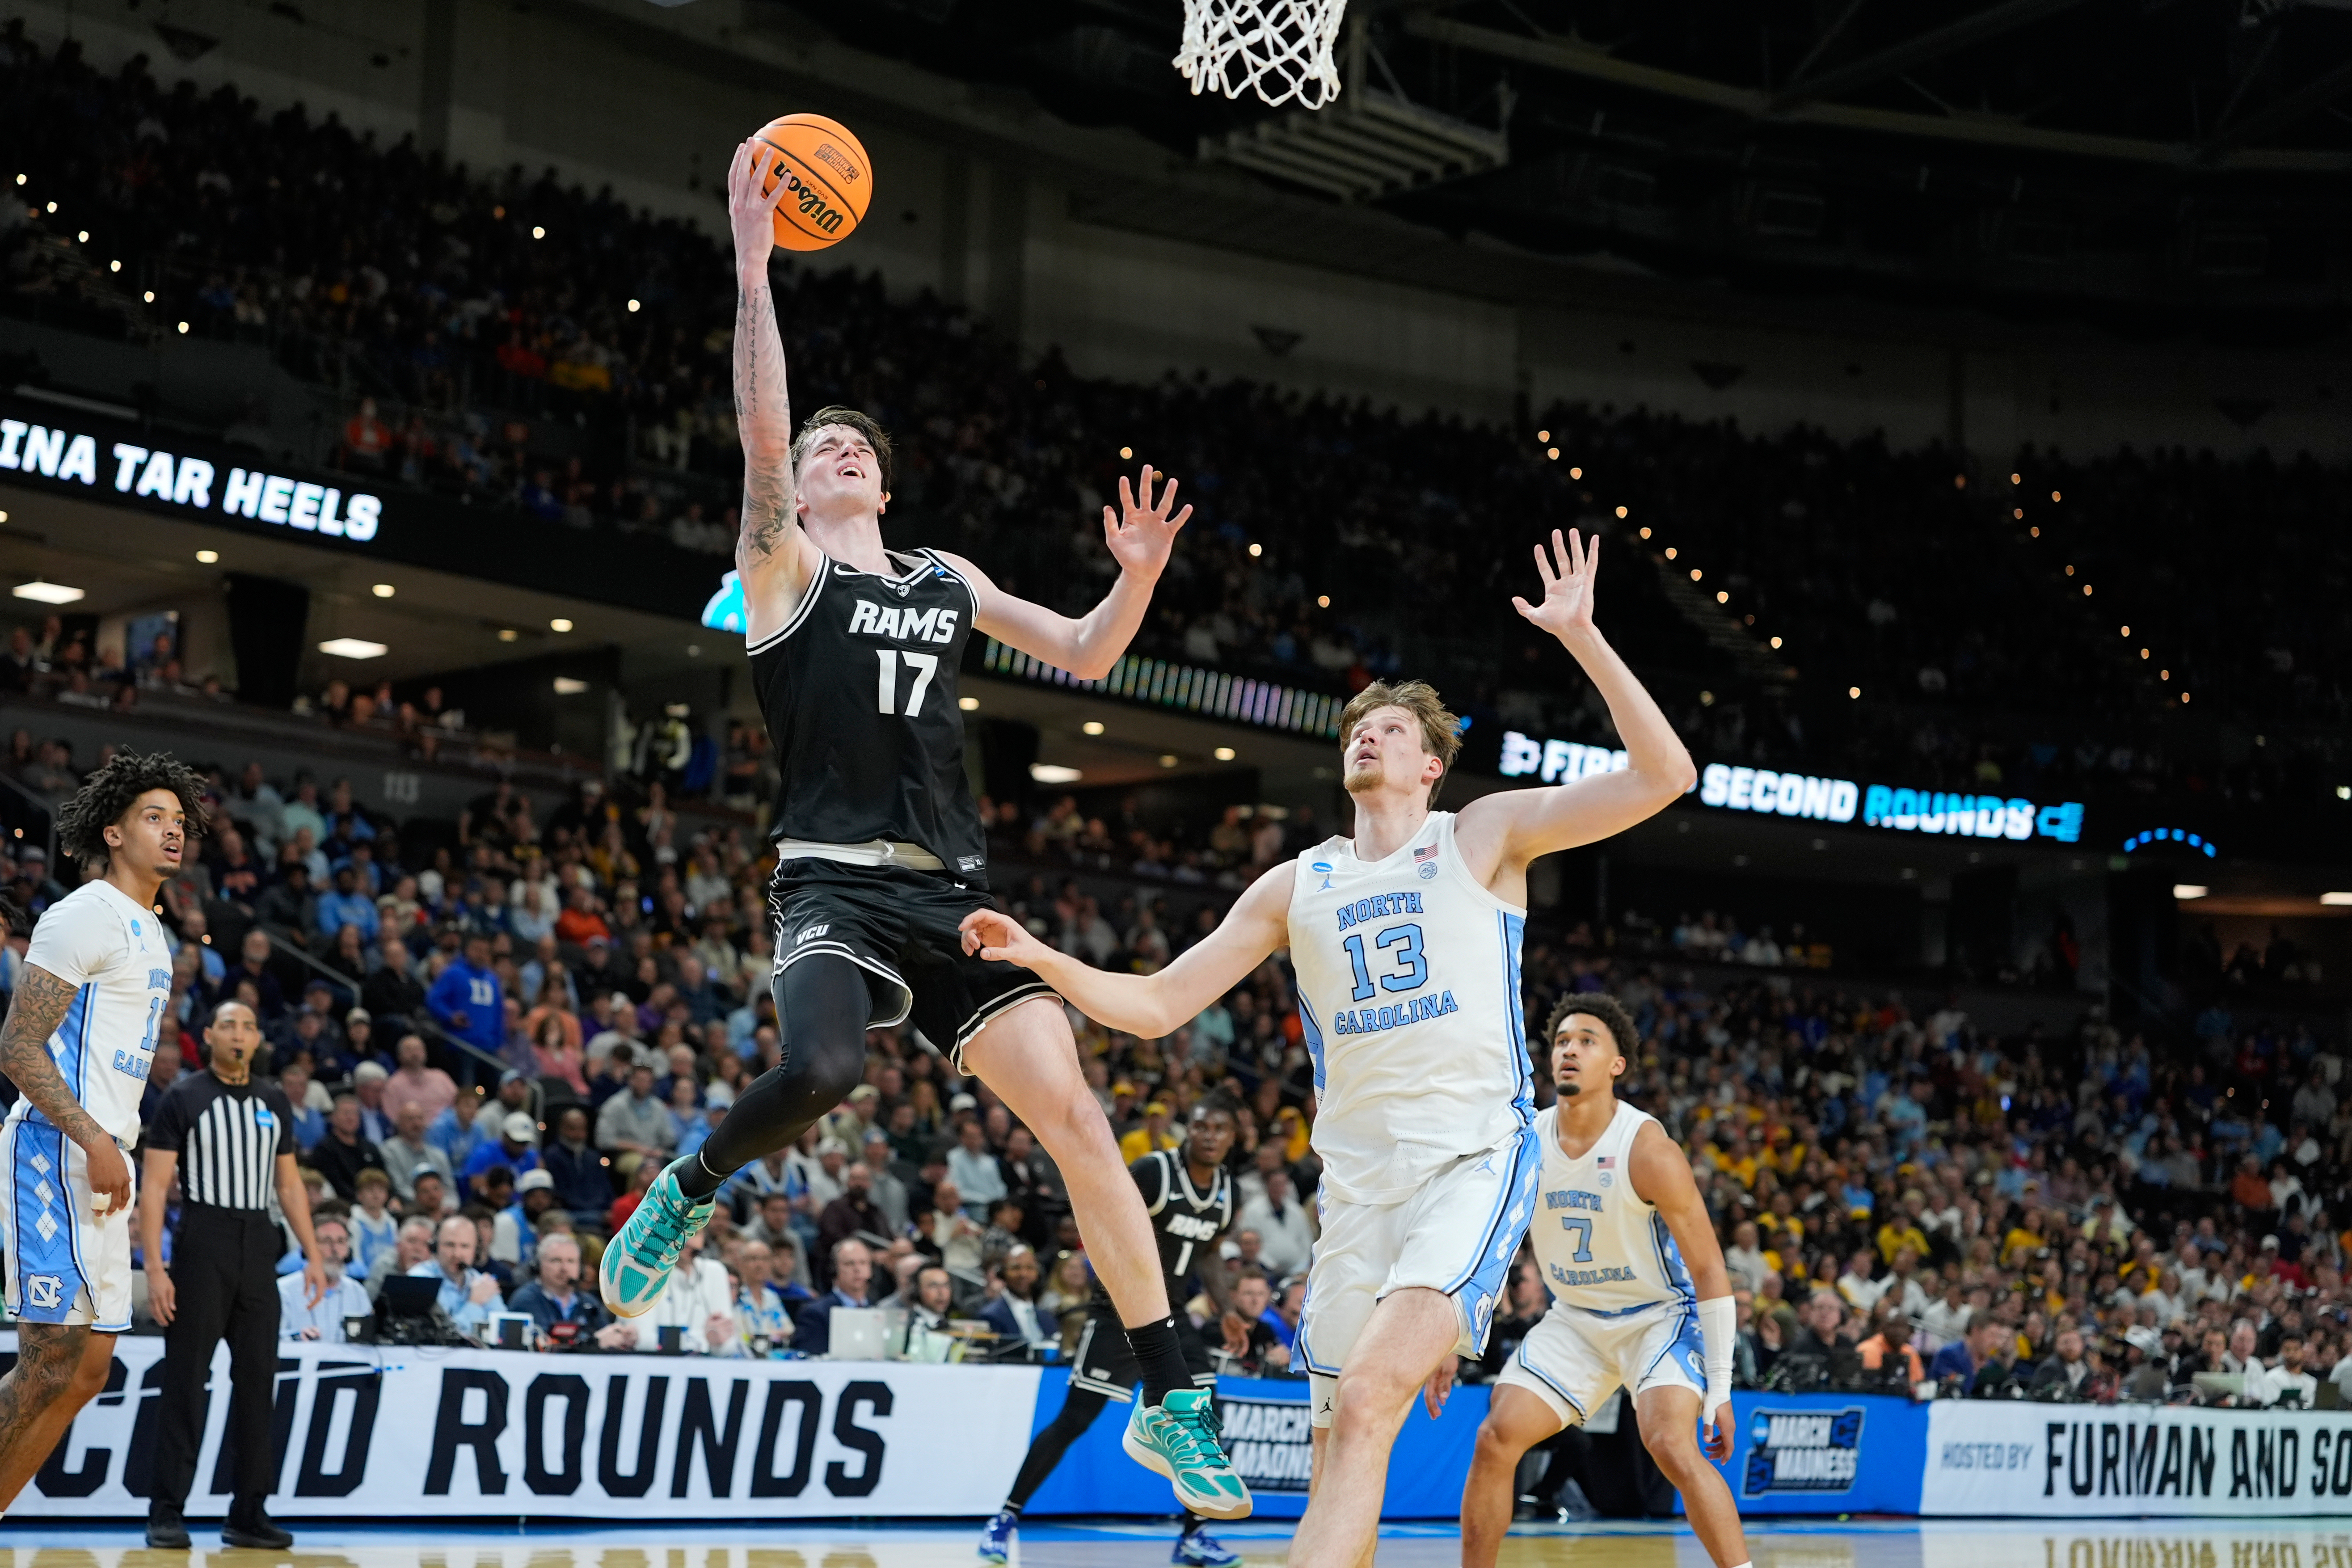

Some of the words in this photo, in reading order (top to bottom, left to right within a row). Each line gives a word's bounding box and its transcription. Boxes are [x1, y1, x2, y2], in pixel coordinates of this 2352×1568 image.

[820, 144, 851, 170] MADNESS
[826, 157, 850, 178] MARCH
[773, 160, 843, 234] Wilson
[805, 180, 817, 190] NXT
[818, 189, 828, 200] EVO
[0, 418, 96, 485] INA
[113, 443, 215, 509] TAR
[223, 467, 383, 542] HEELS
[848, 599, 959, 644] RAMS
[876, 649, 938, 717] 17
[1700, 763, 1859, 823] SECOND
[1864, 784, 2036, 840] ROUNDS
[1337, 892, 1424, 932] NORTH
[797, 924, 830, 945] VCU
[148, 969, 173, 993] NORT
[1343, 923, 1428, 1002] 13
[1335, 990, 1458, 1035] CAROLINA
[1545, 1190, 1604, 1212] NORTH
[1165, 1213, 1219, 1242] RAMS
[1562, 1217, 1593, 1263] 7
[1174, 1240, 1194, 1277] 1
[1550, 1263, 1636, 1286] CAROLINA
[423, 1367, 894, 1498] ROUNDS
[1219, 1402, 1311, 1443] MARCH
[1766, 1415, 1833, 1449] MARCH
[1774, 1448, 1859, 1481] MADNESS
[1940, 1442, 2004, 1470] HOSTED
[2006, 1444, 2035, 1470] BY
[2043, 1421, 2216, 1497] FURMAN
[2228, 1428, 2299, 1498] AND
